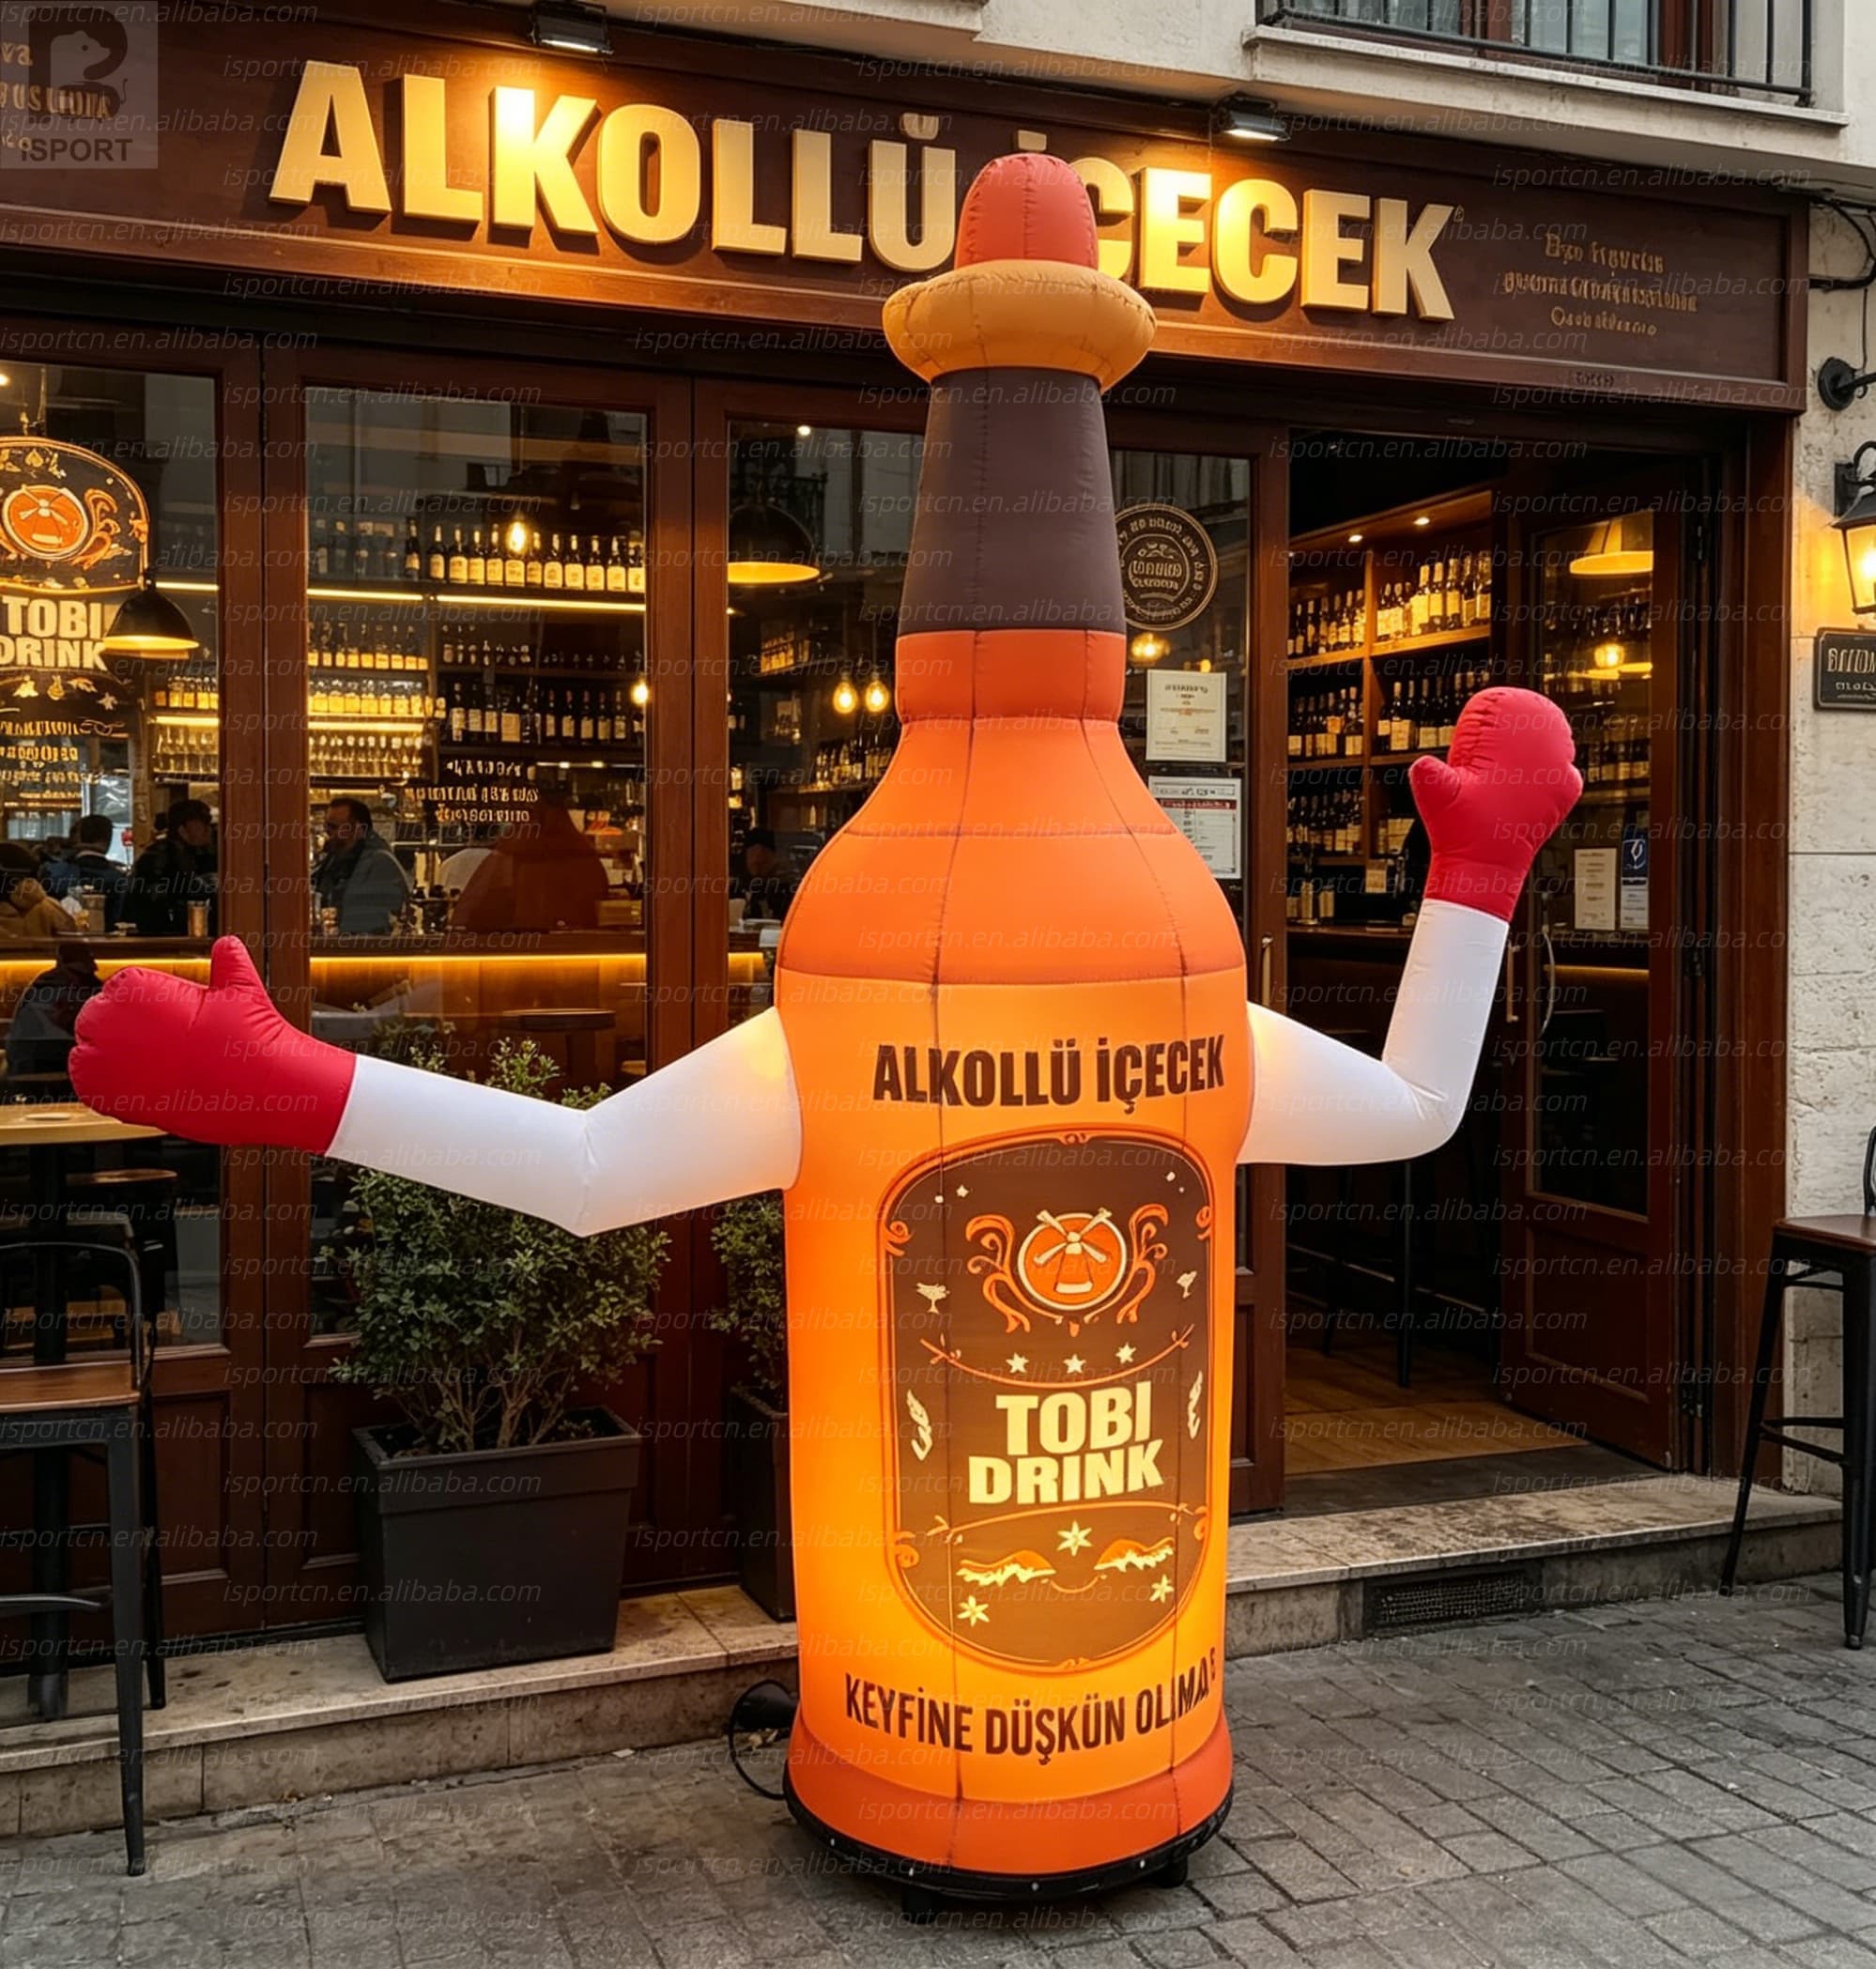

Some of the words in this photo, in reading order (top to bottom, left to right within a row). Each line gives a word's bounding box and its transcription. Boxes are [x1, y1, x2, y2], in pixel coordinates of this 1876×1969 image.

[269, 60, 956, 272] ALKOLLÜ
[2, 594, 103, 639] TOBI
[872, 1038, 1082, 1107] ALKOLLÜ
[1097, 1035, 1225, 1115] İÇECEK
[995, 1380, 1152, 1456] TOBI
[968, 1438, 1165, 1505] DRINK
[845, 1672, 974, 1753] KEYFİNE
[984, 1692, 1126, 1766] DÜŞKÜN
